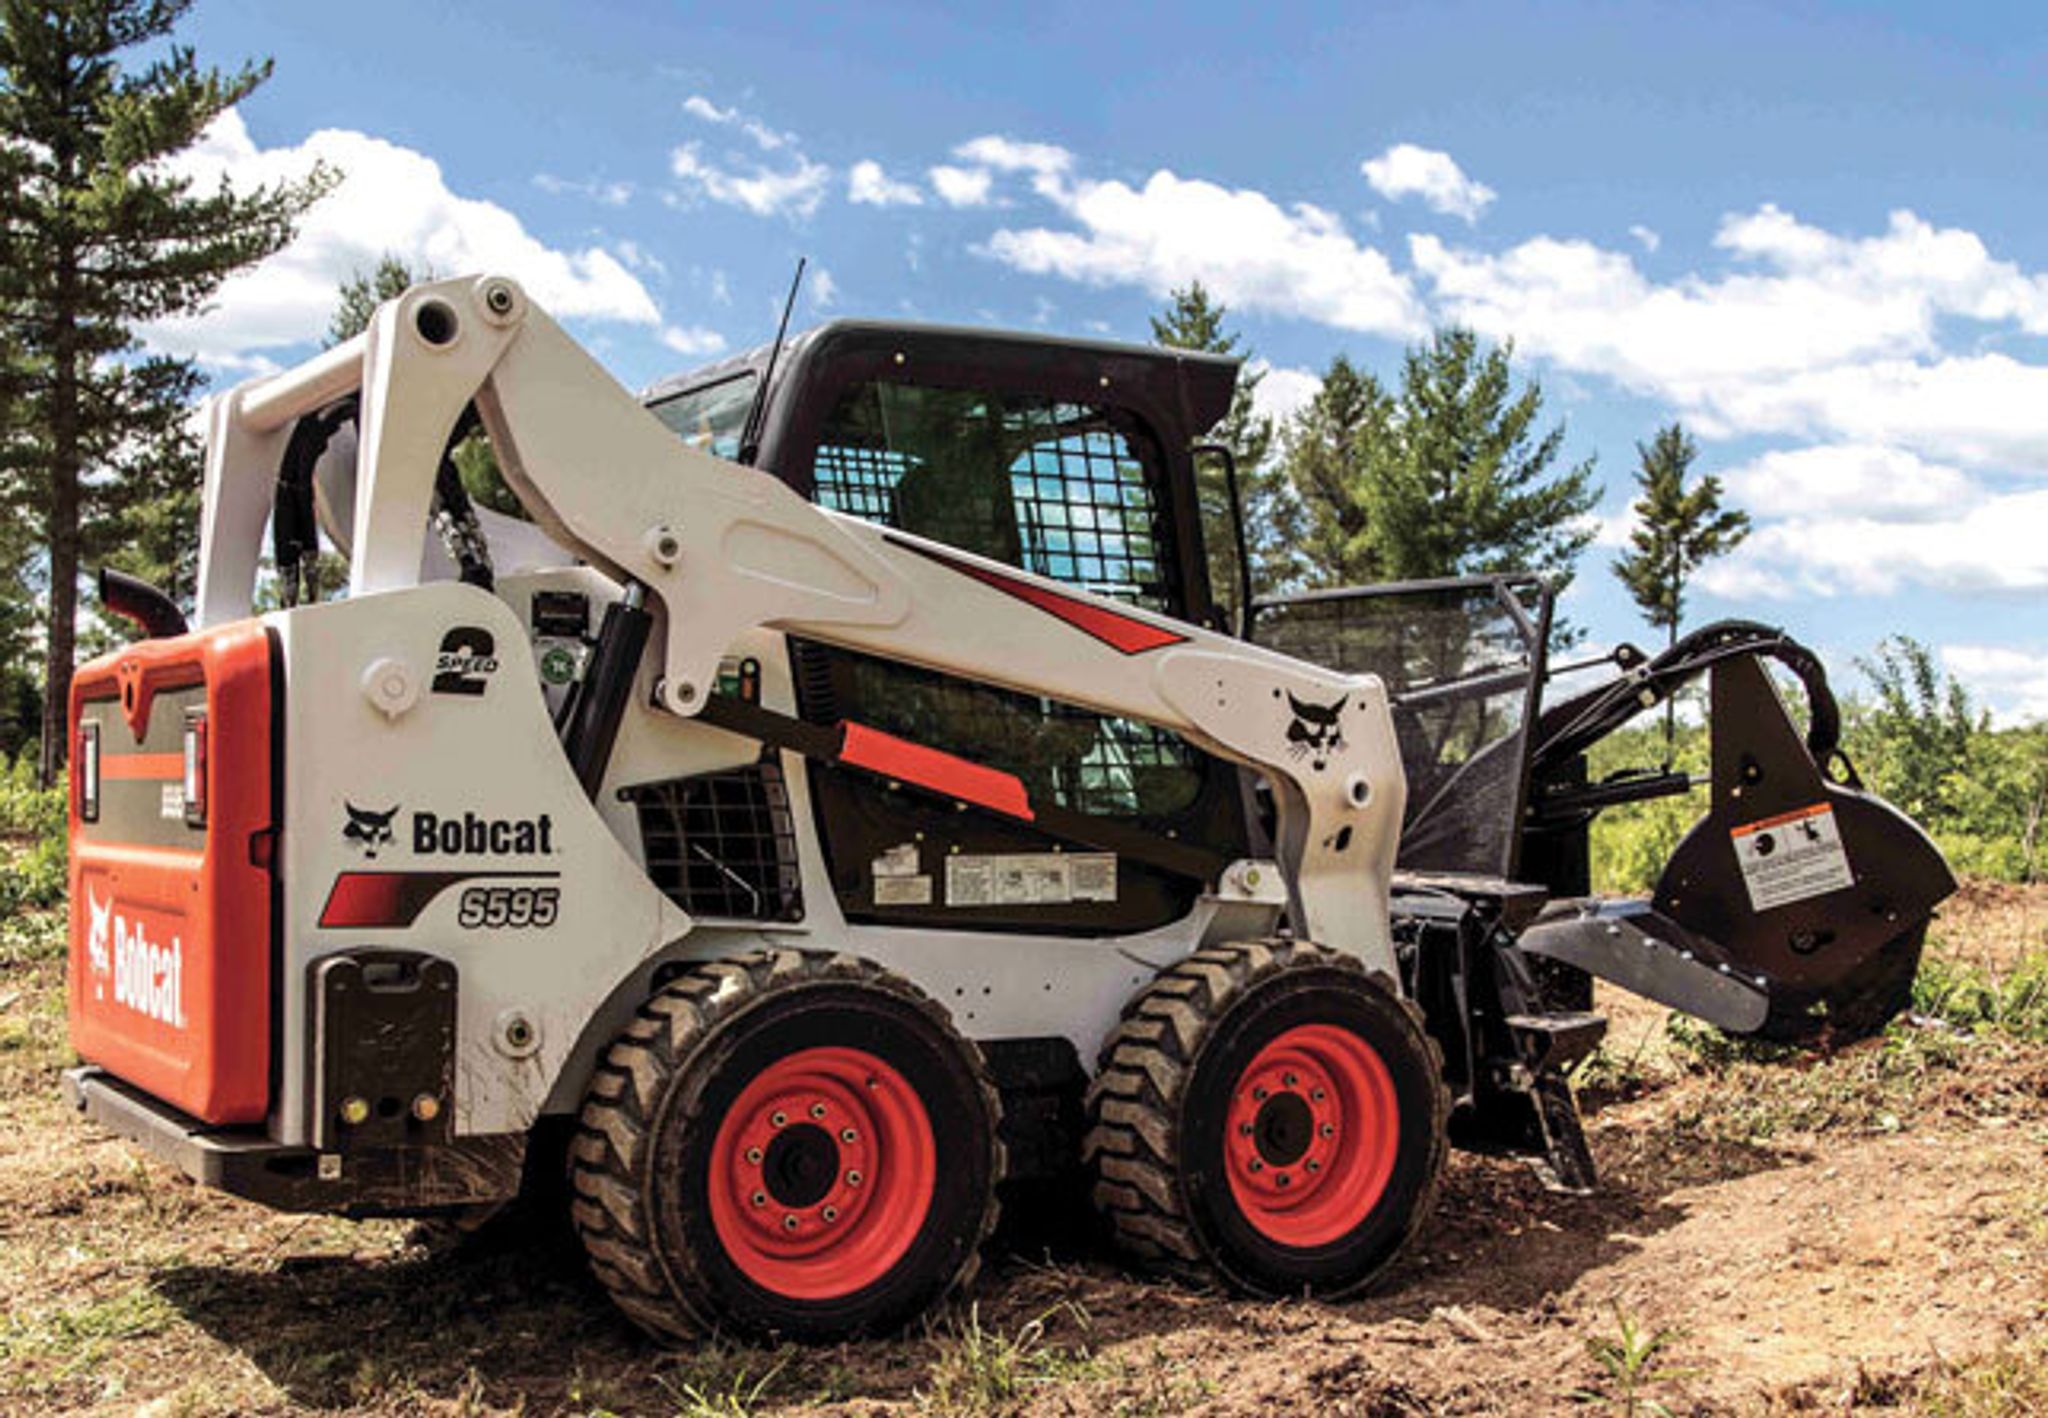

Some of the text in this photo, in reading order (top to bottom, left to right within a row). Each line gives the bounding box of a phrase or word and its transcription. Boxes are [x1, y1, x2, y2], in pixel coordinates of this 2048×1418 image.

[432, 626, 494, 695] 2
[436, 655, 498, 672] SPEED
[413, 811, 552, 853] Bobcat
[458, 887, 560, 929] S595
[115, 915, 184, 1029] Bobcat
